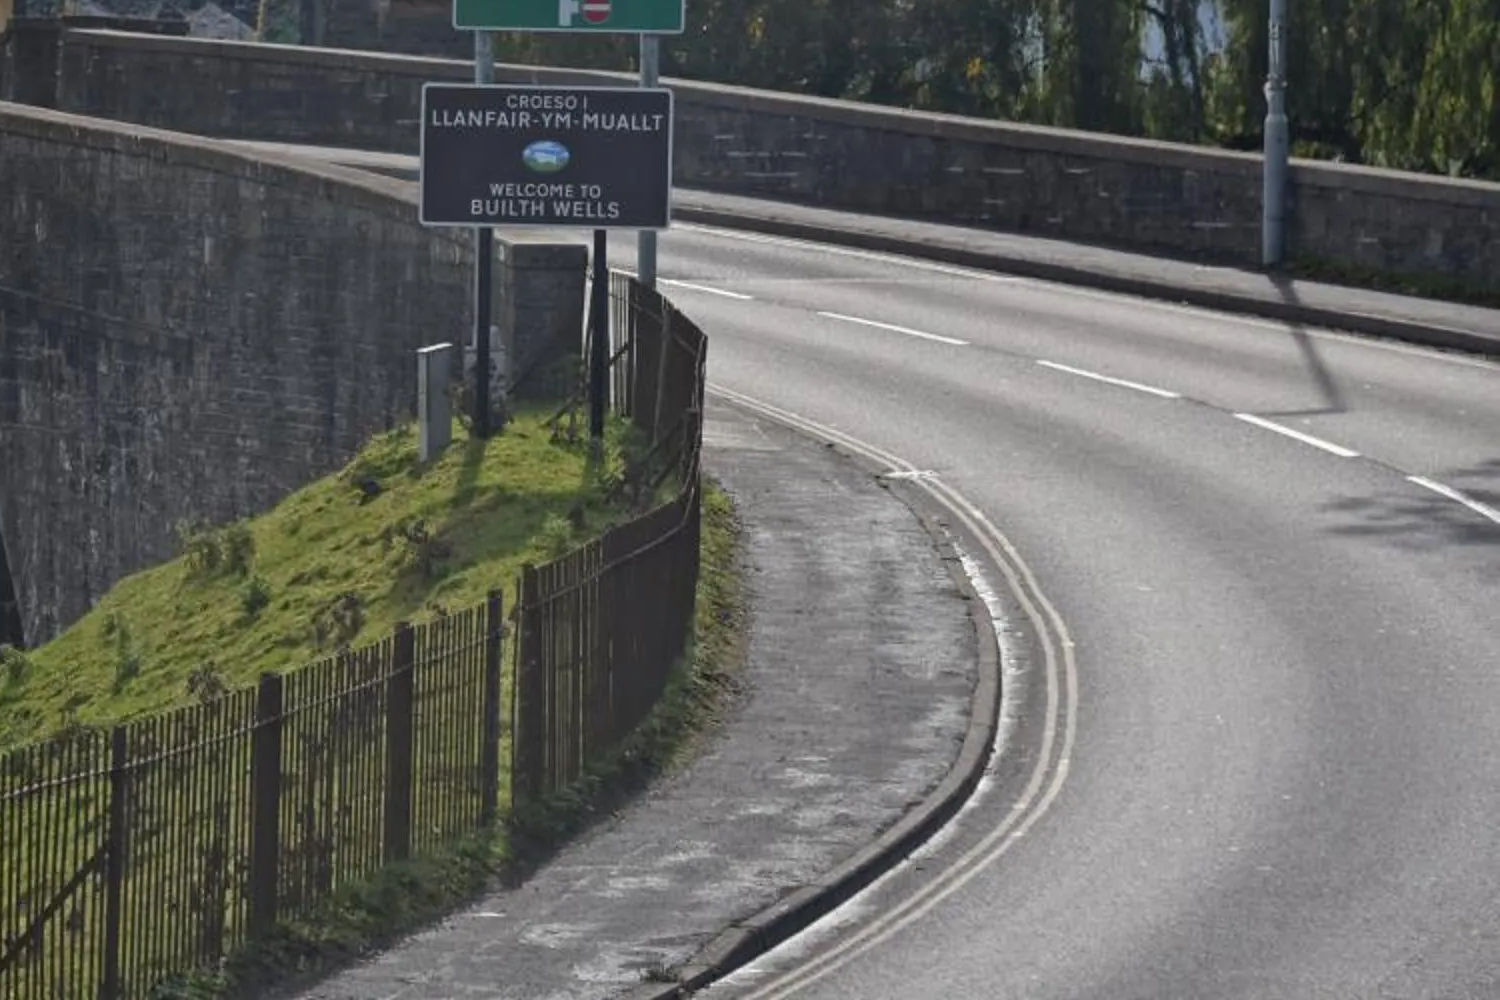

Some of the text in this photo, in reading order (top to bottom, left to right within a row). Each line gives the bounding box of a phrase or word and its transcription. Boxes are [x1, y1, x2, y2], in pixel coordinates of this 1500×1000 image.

[506, 95, 578, 110] CROESO
[432, 110, 664, 131] LLANFAIR-YM-MUALLT
[490, 183, 601, 199] WELCOME TO
[471, 199, 621, 218] BUILTH WELLS
